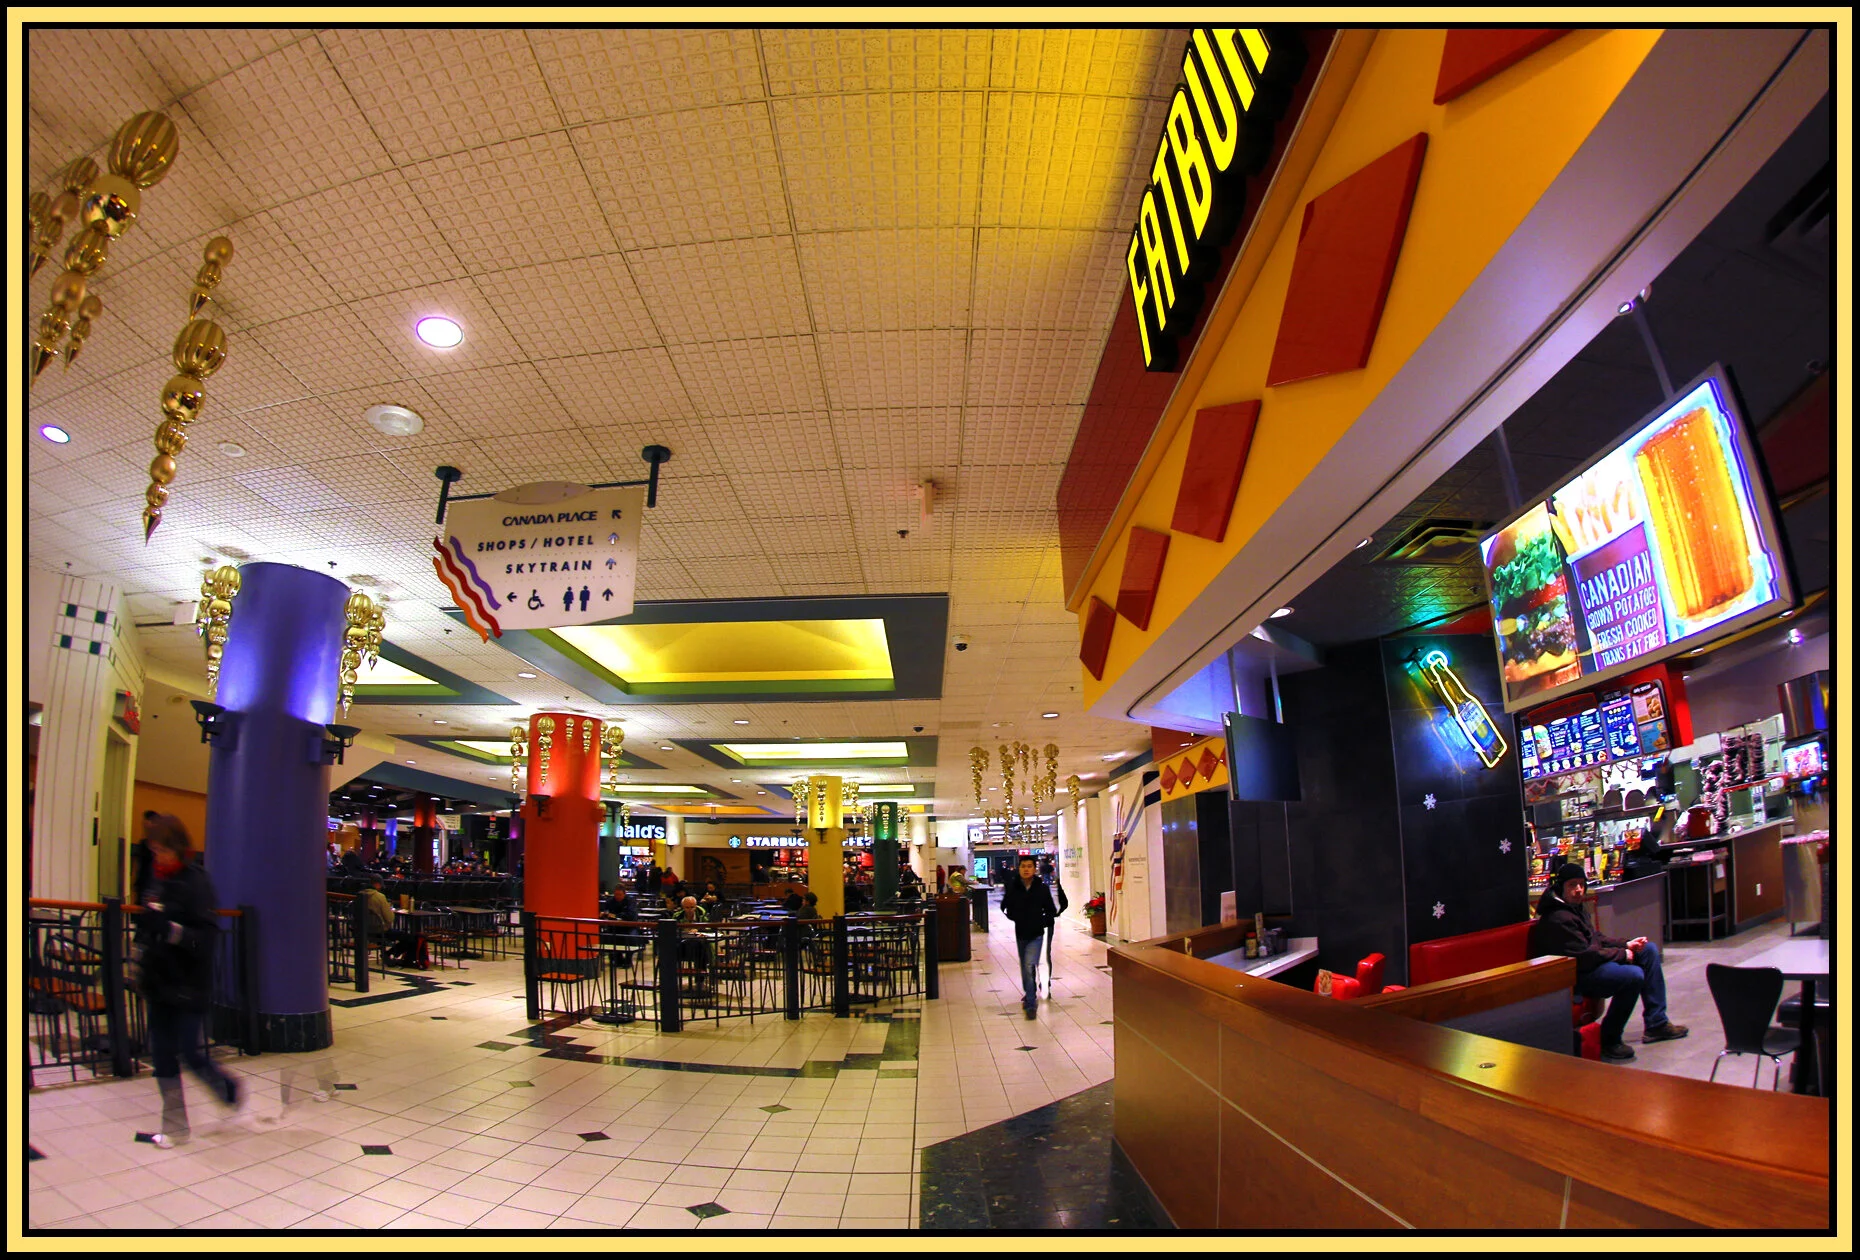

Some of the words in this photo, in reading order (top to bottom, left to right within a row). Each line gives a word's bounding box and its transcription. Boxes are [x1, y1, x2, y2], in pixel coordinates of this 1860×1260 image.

[502, 513, 554, 527] CANADA
[557, 510, 598, 523] PLACE
[477, 538, 526, 552] SHOPS
[543, 535, 594, 548] HOTEL
[505, 560, 592, 574] SKYTRAIN
[1580, 550, 1652, 610] CANADIAN
[1614, 586, 1657, 619] POTATOES
[1597, 625, 1624, 650] FRESH
[1624, 608, 1657, 638] COOKED
[1601, 647, 1626, 667] TRANS
[1626, 639, 1642, 660] FAT
[1644, 630, 1661, 652] FREE
[746, 836, 809, 847] STARBUC
